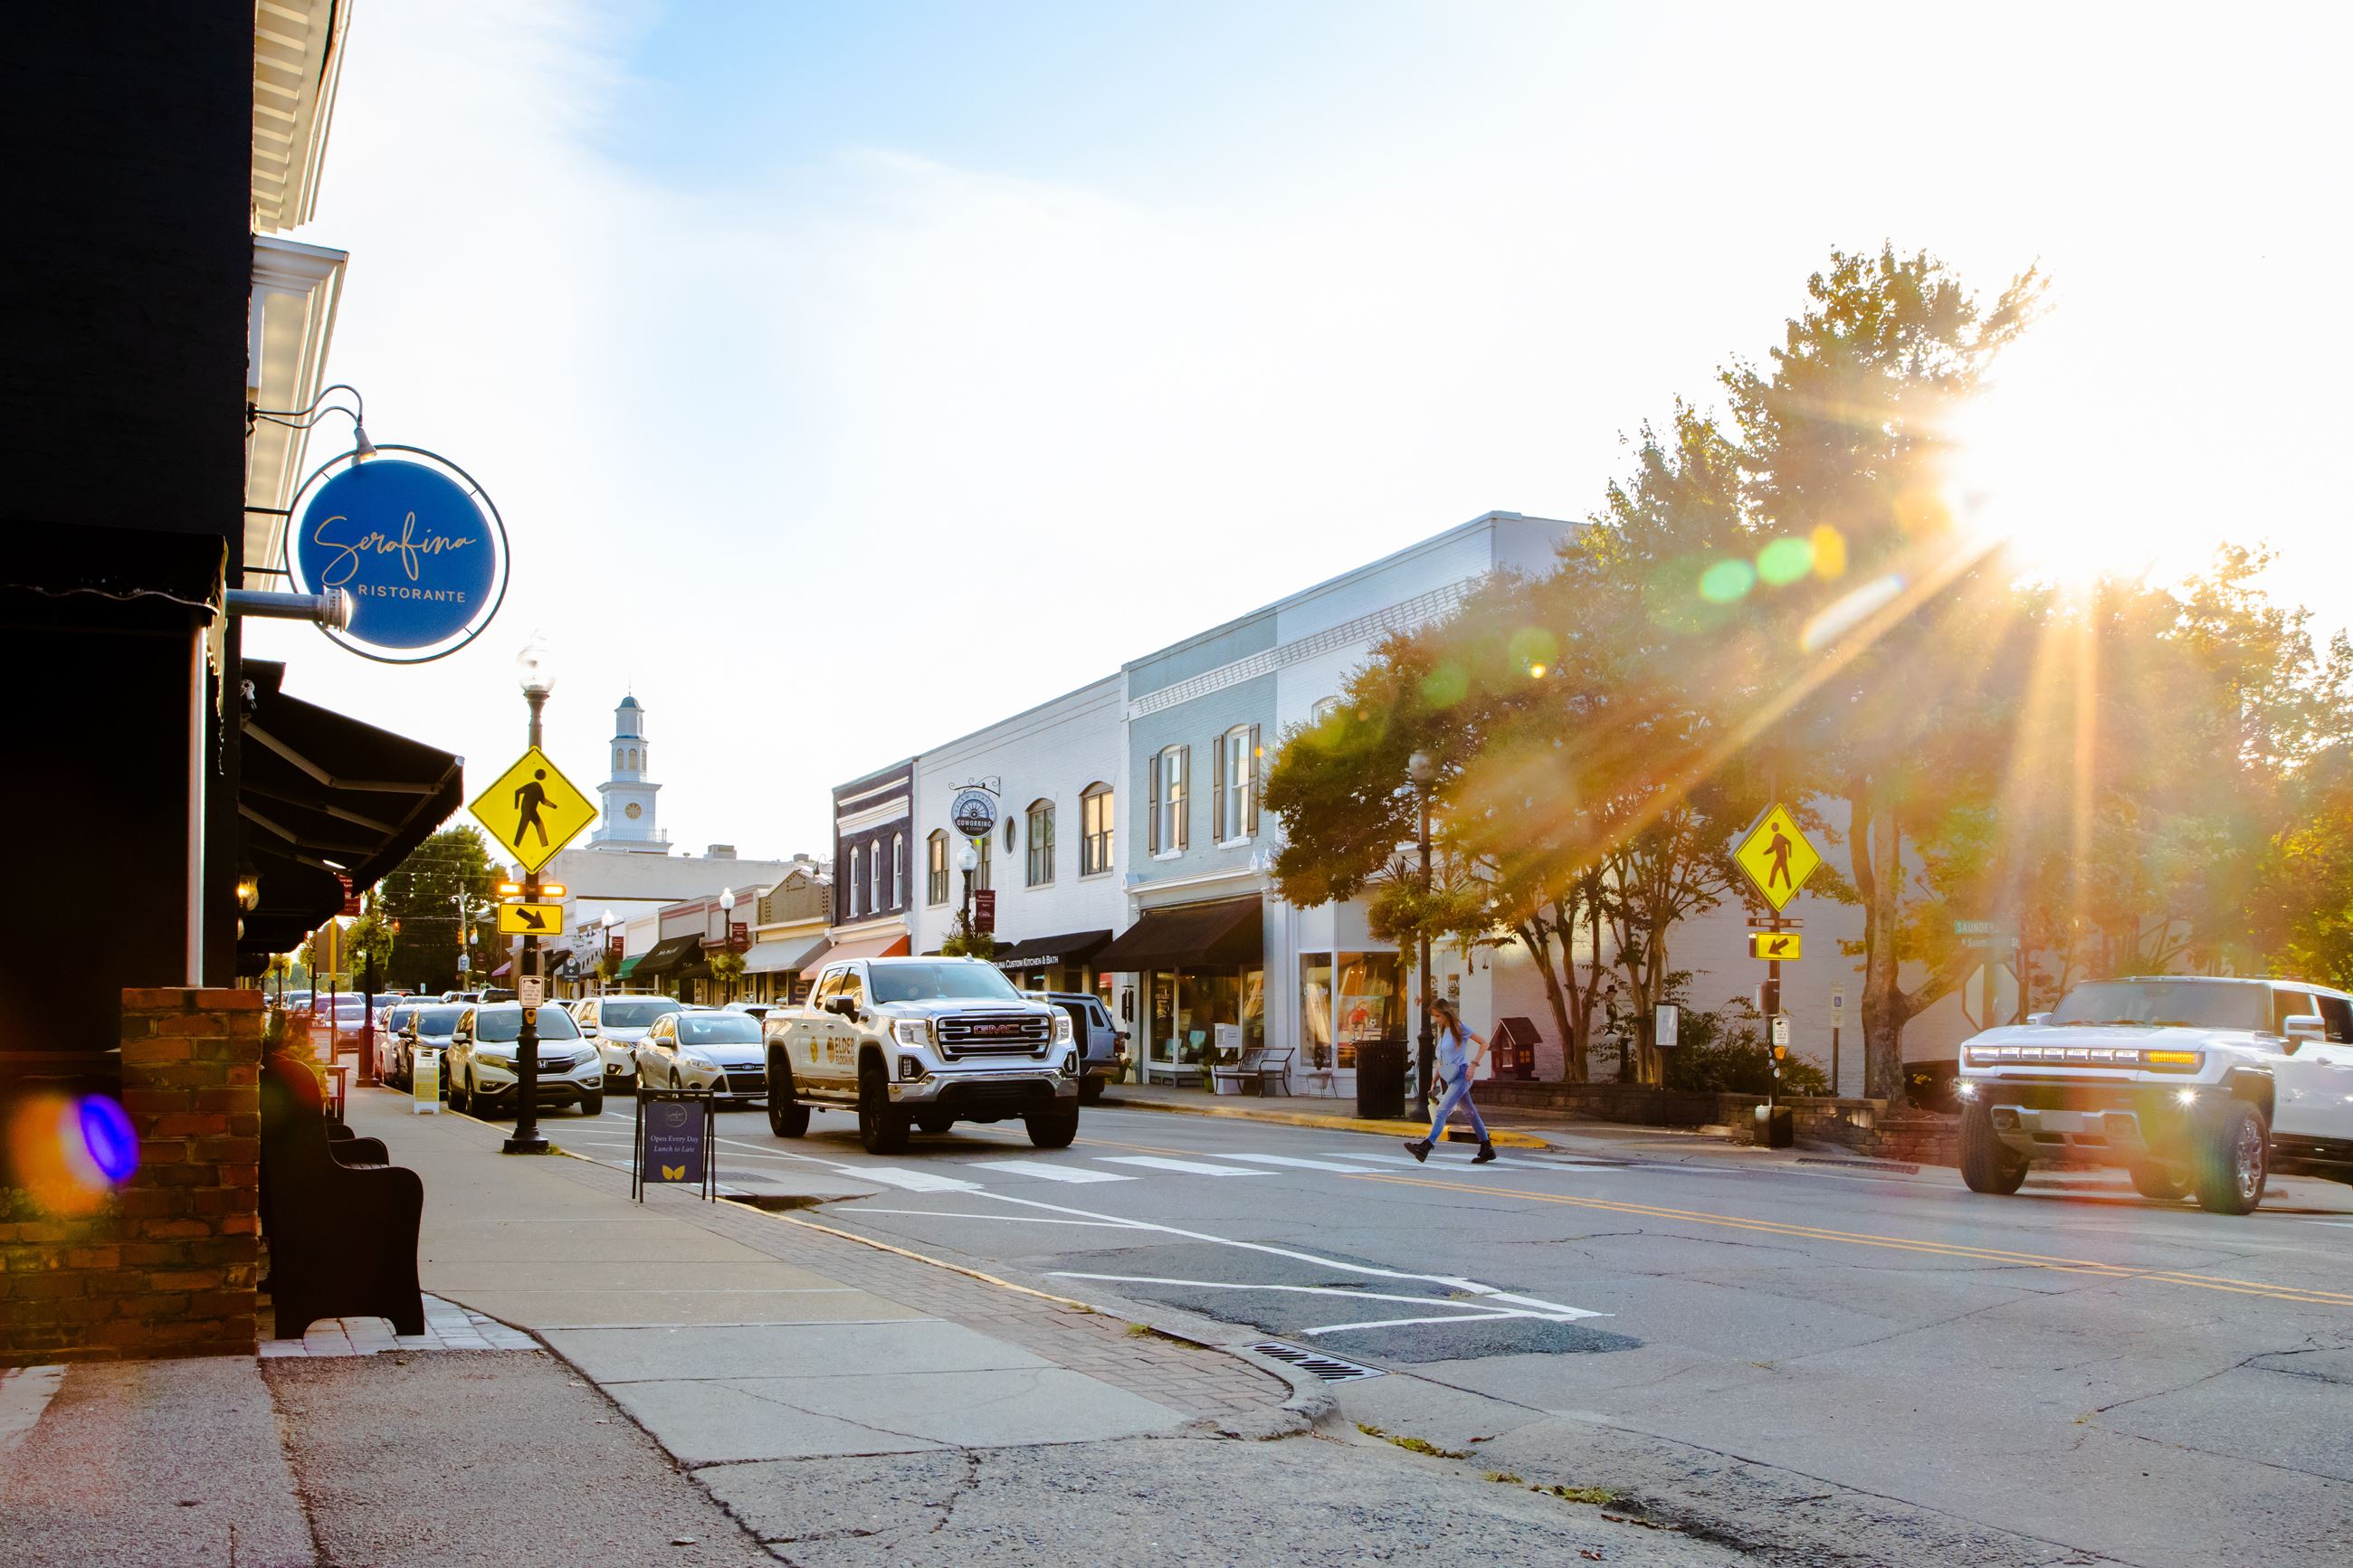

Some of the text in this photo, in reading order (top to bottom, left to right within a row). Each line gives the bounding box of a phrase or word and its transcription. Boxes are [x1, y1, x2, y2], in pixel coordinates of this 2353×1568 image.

[314, 511, 477, 586] Serafina
[358, 584, 466, 603] RISTORANTE
[973, 794, 995, 815] STATION
[973, 1024, 1020, 1034] GMC
[835, 1037, 855, 1054] ELDER
[835, 1055, 855, 1066] FLOORING
[651, 1135, 667, 1143] Open
